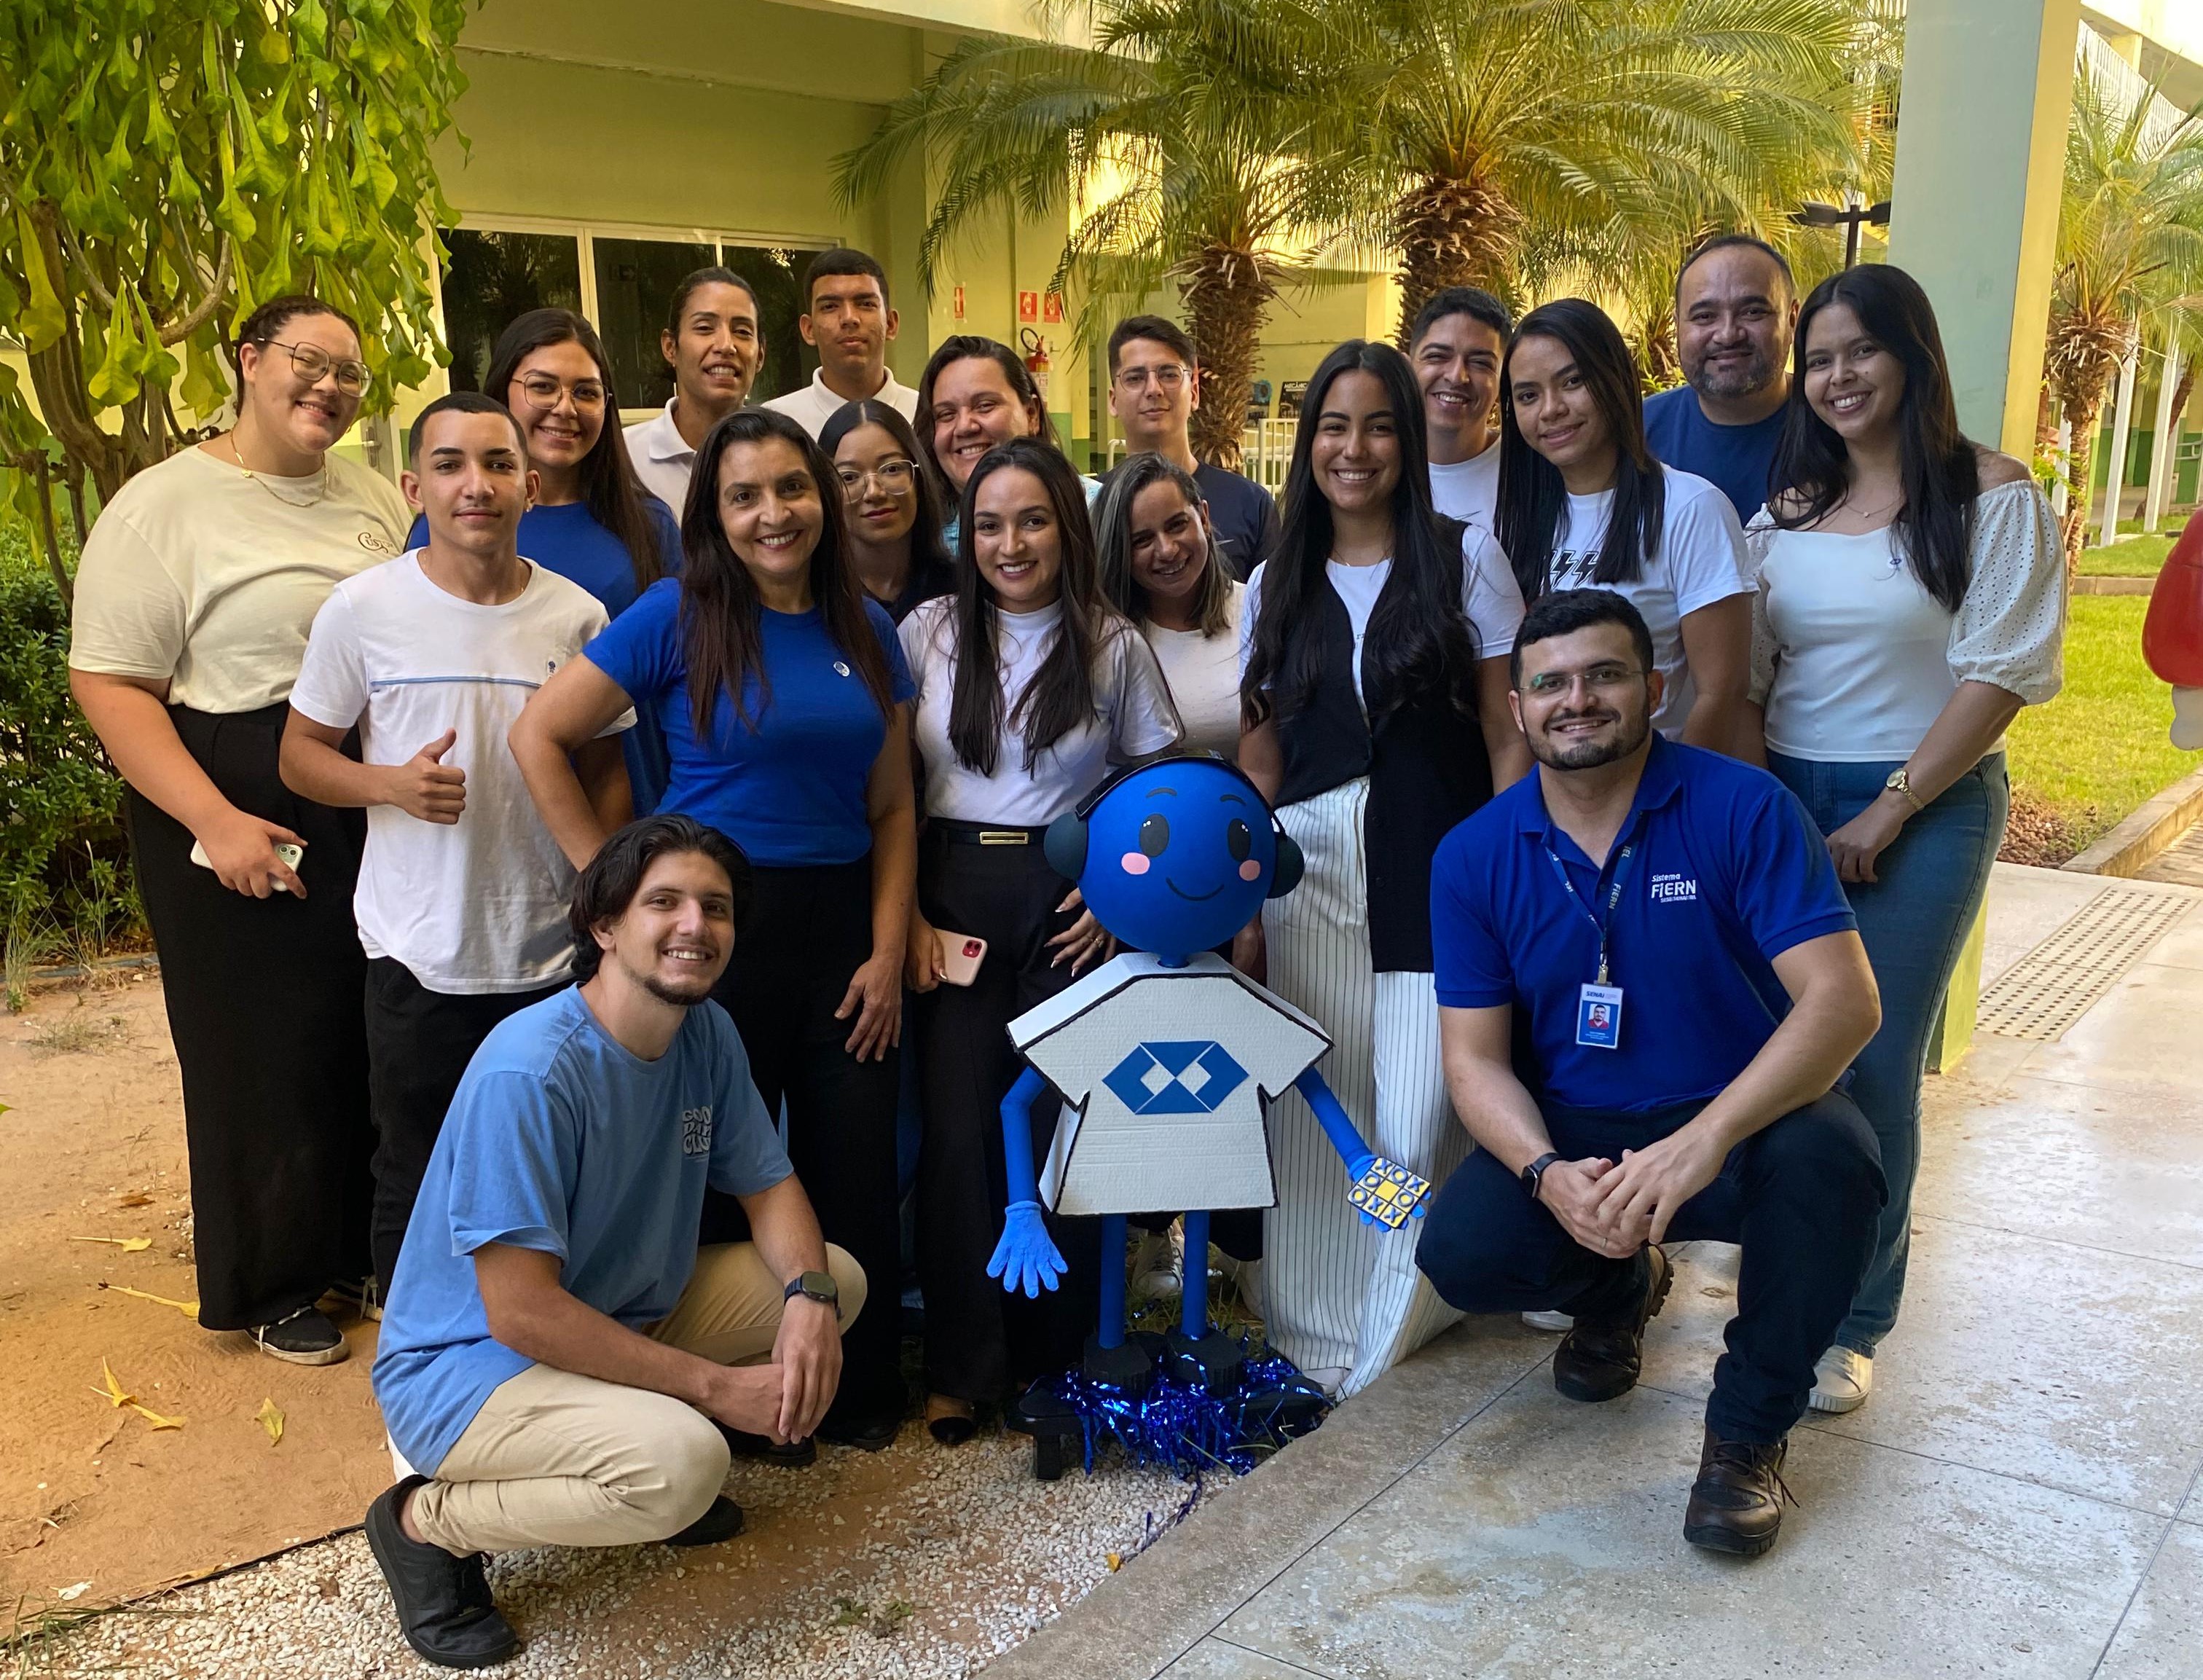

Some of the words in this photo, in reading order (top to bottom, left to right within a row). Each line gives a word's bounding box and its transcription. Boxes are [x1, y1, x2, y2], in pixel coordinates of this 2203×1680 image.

[1652, 874, 1681, 882] Sistema
[1609, 883, 1622, 909] FIERN
[1651, 879, 1697, 898] FIERN
